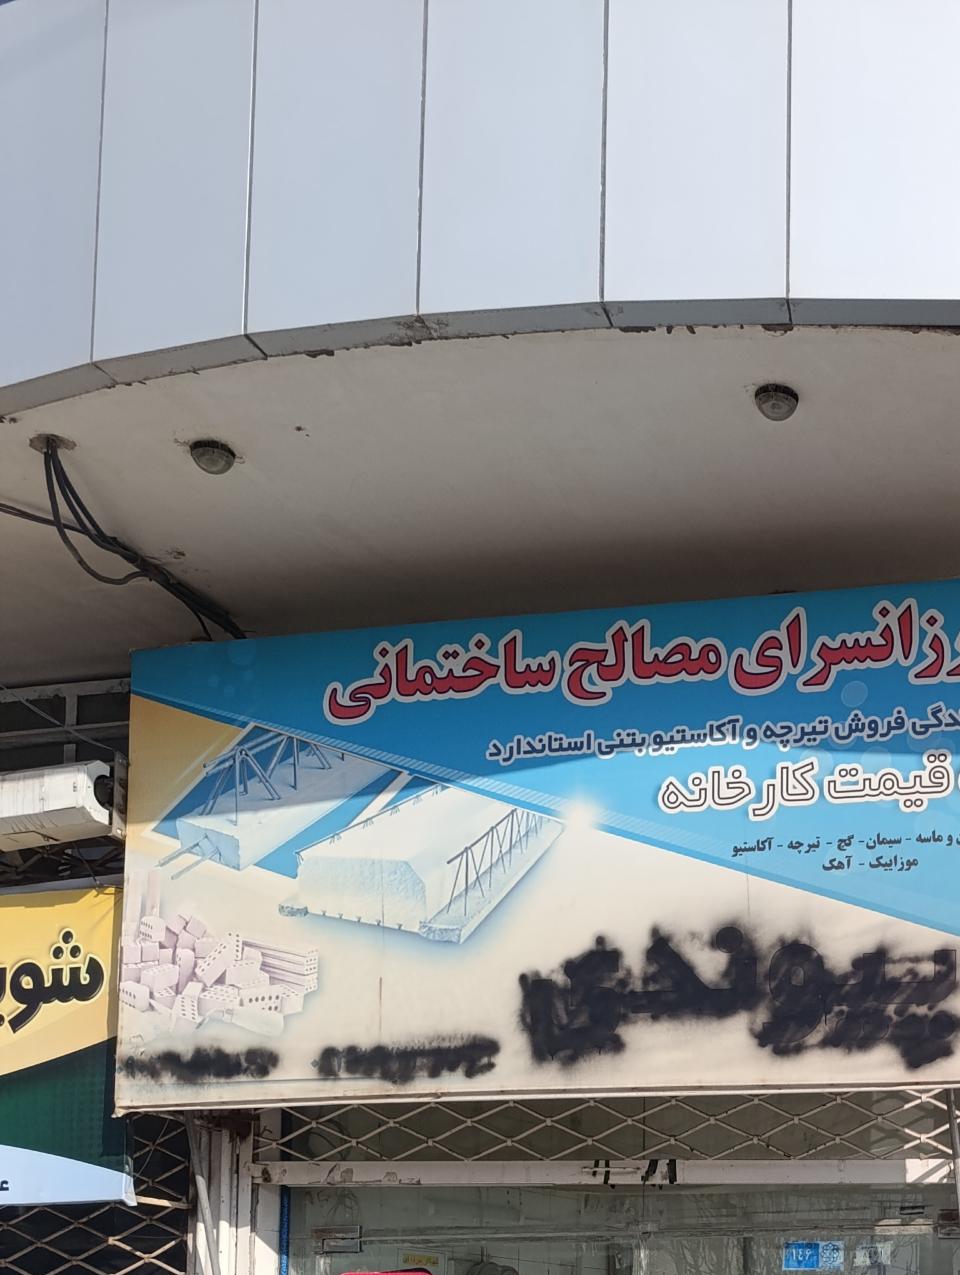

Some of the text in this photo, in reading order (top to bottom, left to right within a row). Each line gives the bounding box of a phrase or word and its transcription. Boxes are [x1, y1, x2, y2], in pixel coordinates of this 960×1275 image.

[327, 633, 558, 721] ساختمانی
[565, 622, 724, 702] مصالح
[652, 717, 740, 753] آکاستیو
[745, 727, 758, 746] و
[763, 716, 829, 749] تیرچه
[835, 707, 906, 741] فروش
[488, 731, 594, 763] استاندارد
[599, 729, 647, 758] بتنی
[828, 753, 951, 809] قیمت
[731, 837, 774, 857] آکاستیو
[787, 836, 820, 854] تیرچه
[837, 834, 854, 851] گچ
[915, 829, 943, 843] ماسه
[822, 855, 919, 871] موزاییک آهک
